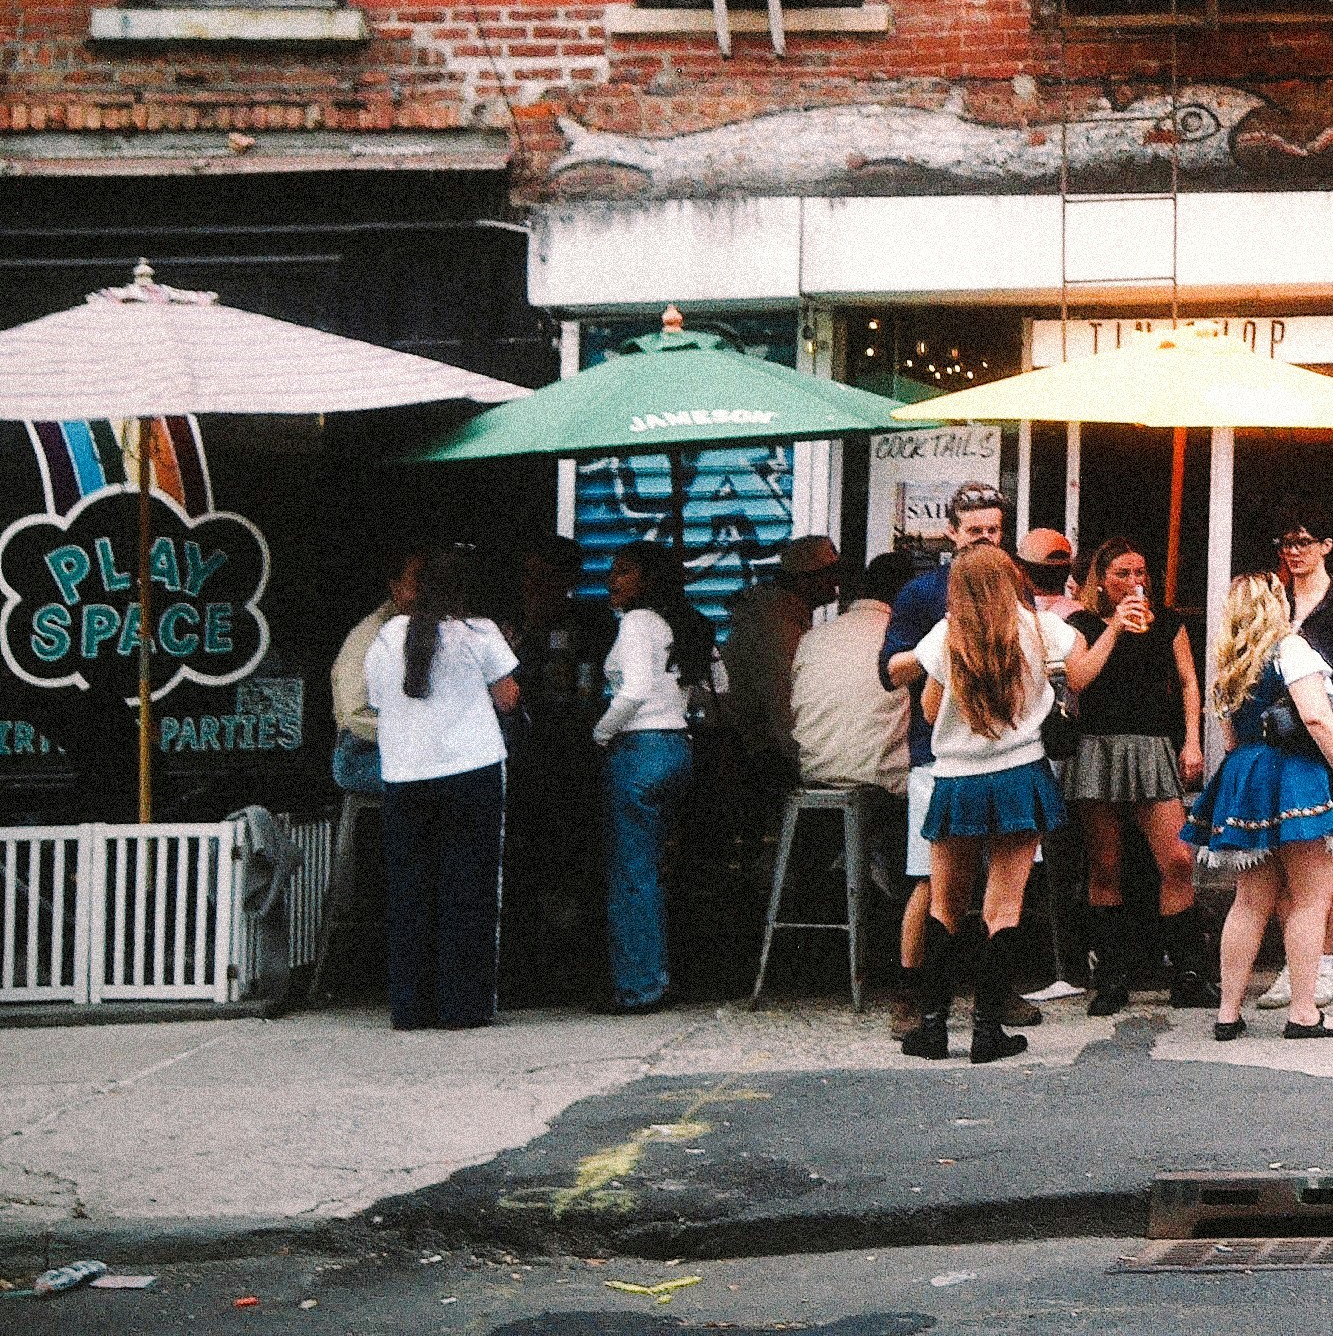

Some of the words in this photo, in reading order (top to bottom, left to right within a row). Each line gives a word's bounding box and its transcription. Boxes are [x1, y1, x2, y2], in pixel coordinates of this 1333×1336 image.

[629, 408, 777, 434] JAMESON
[43, 536, 228, 606] PLAY
[31, 602, 233, 662] SPACE
[159, 714, 303, 753] PARTIES
